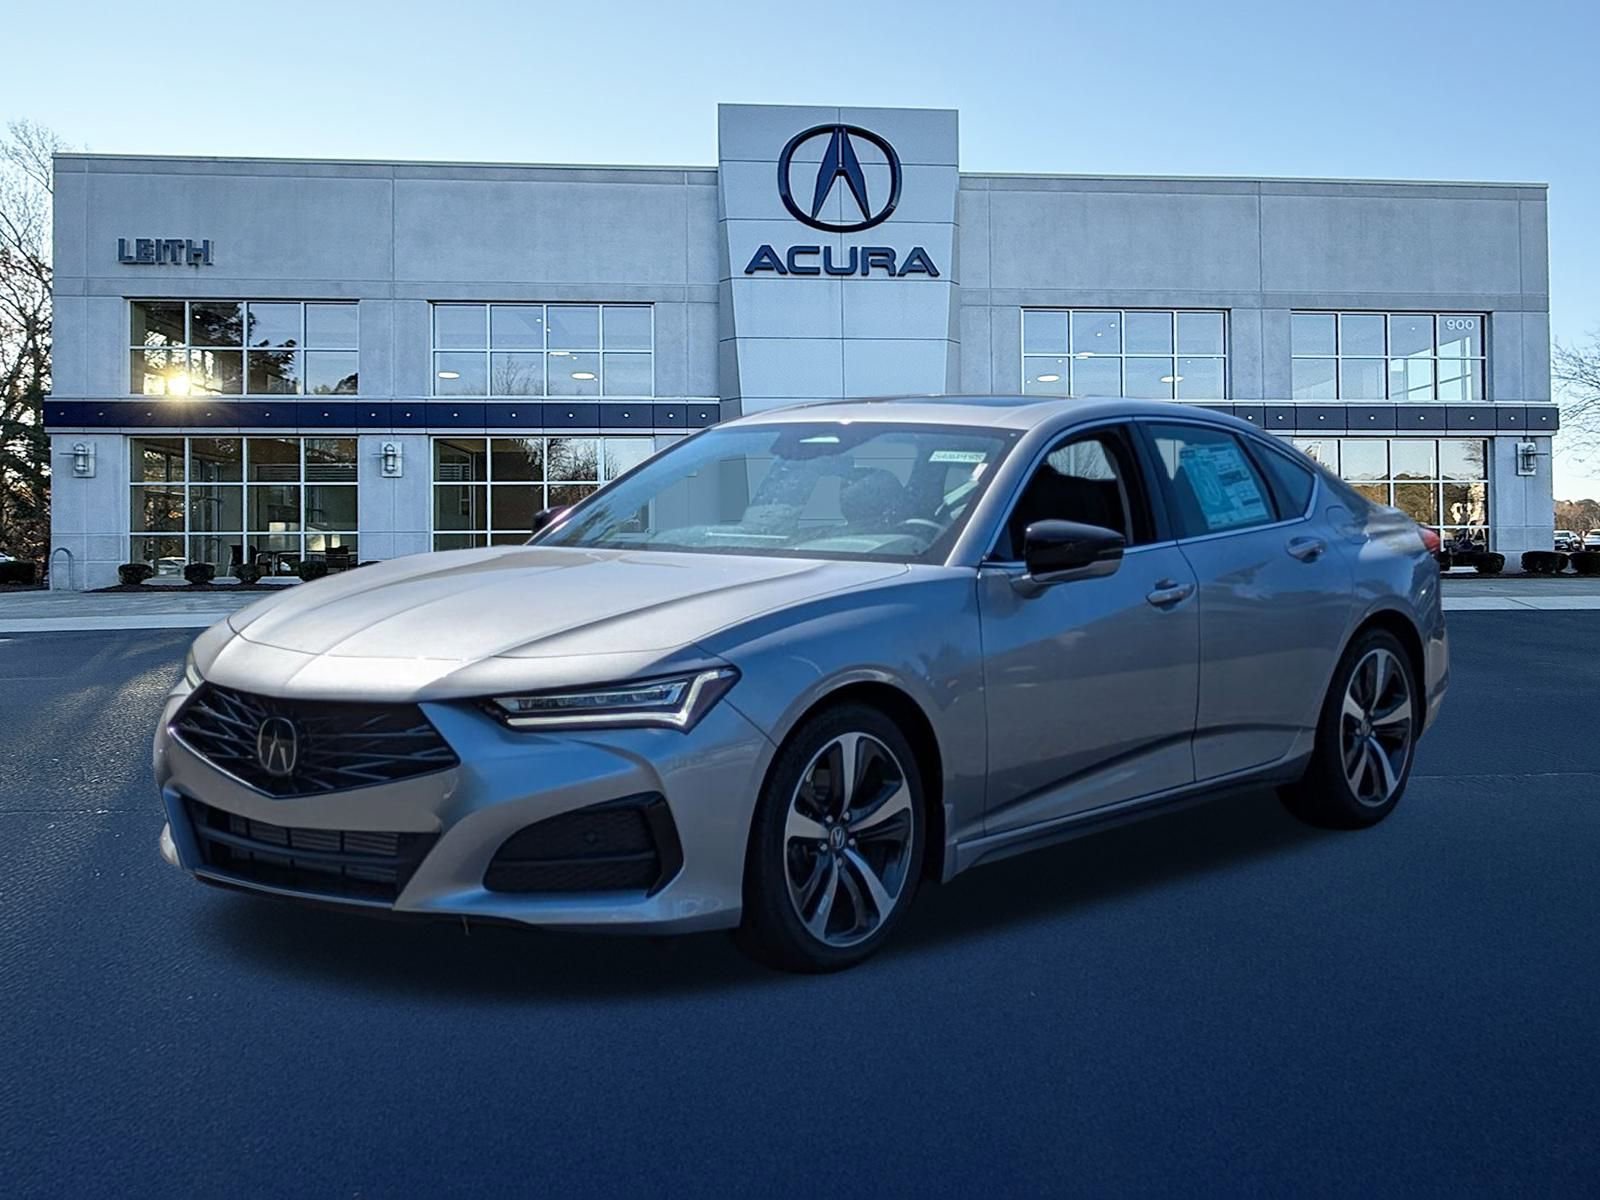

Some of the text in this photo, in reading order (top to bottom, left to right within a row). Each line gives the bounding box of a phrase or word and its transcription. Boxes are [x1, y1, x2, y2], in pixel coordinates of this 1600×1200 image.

[117, 238, 213, 265] LEITH
[744, 244, 940, 277] ACURA
[1446, 319, 1475, 330] 900
